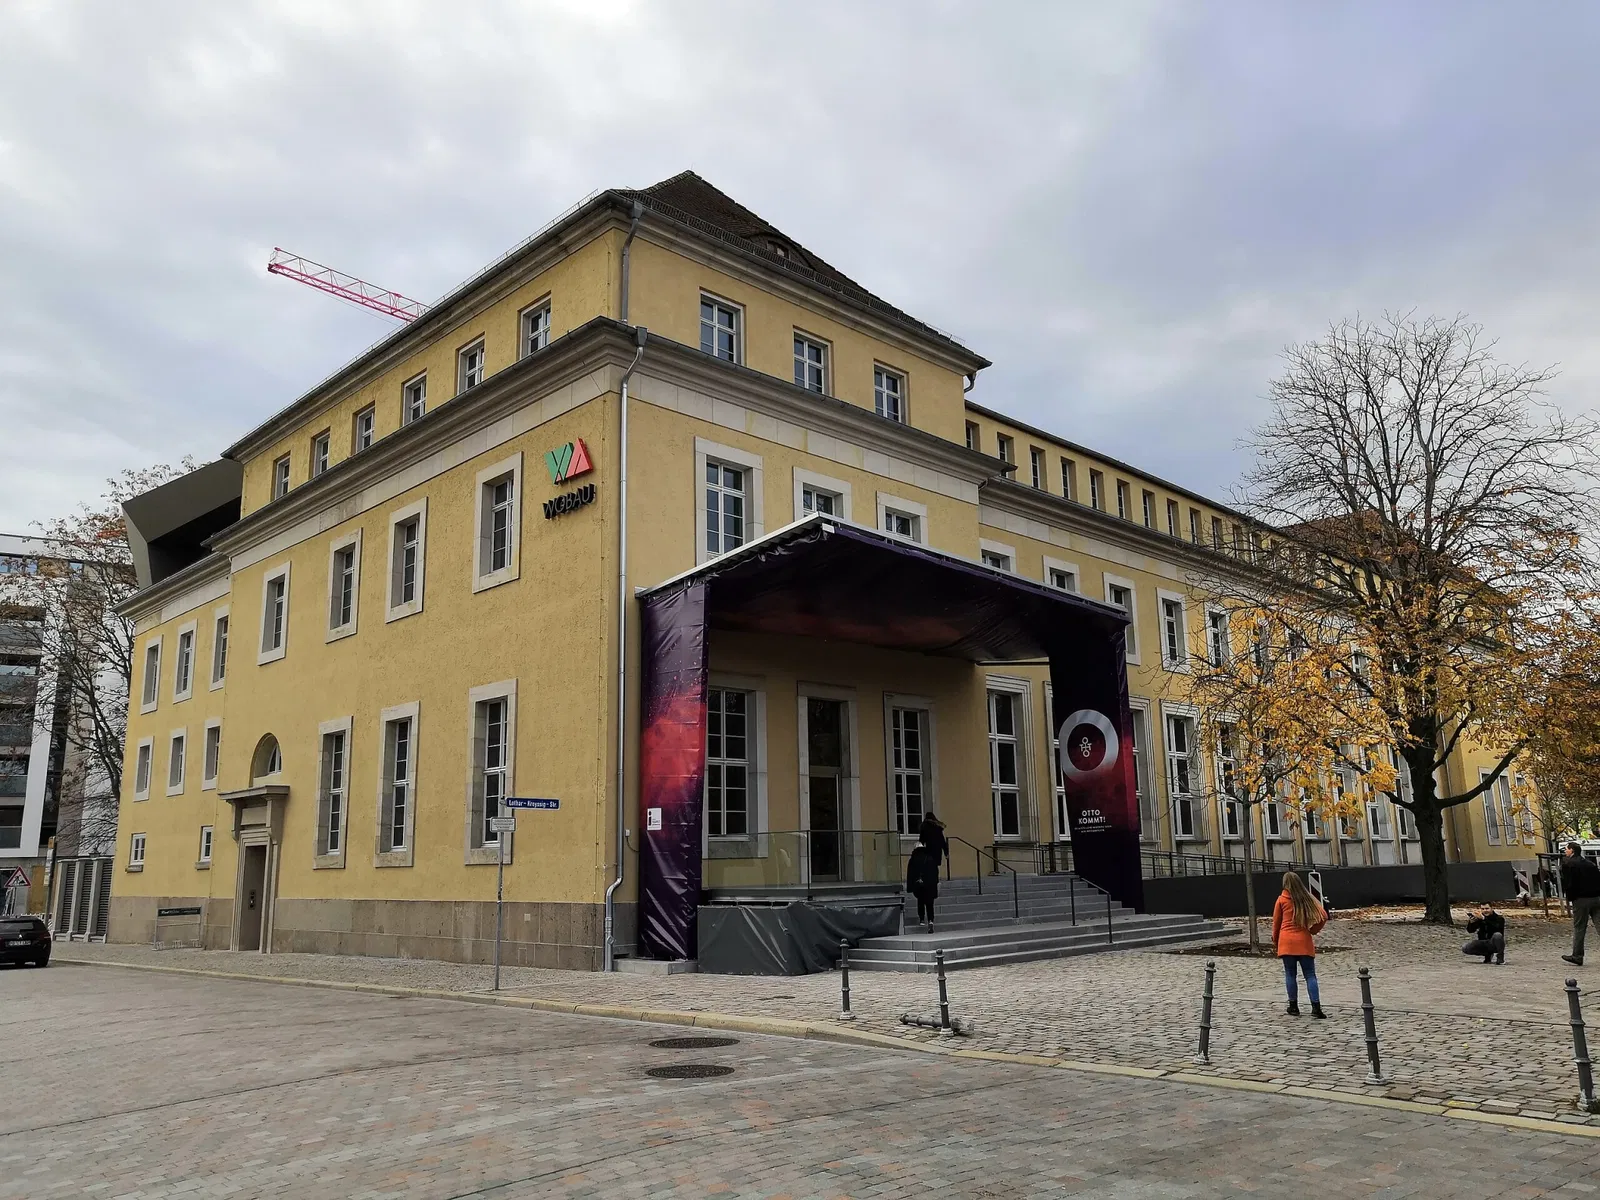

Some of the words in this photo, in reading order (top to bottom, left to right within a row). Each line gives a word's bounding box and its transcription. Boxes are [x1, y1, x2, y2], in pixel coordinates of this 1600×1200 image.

[542, 483, 596, 520] WOBAU
[1081, 809, 1101, 817] OTTO
[1078, 816, 1106, 825] KOMMT!
